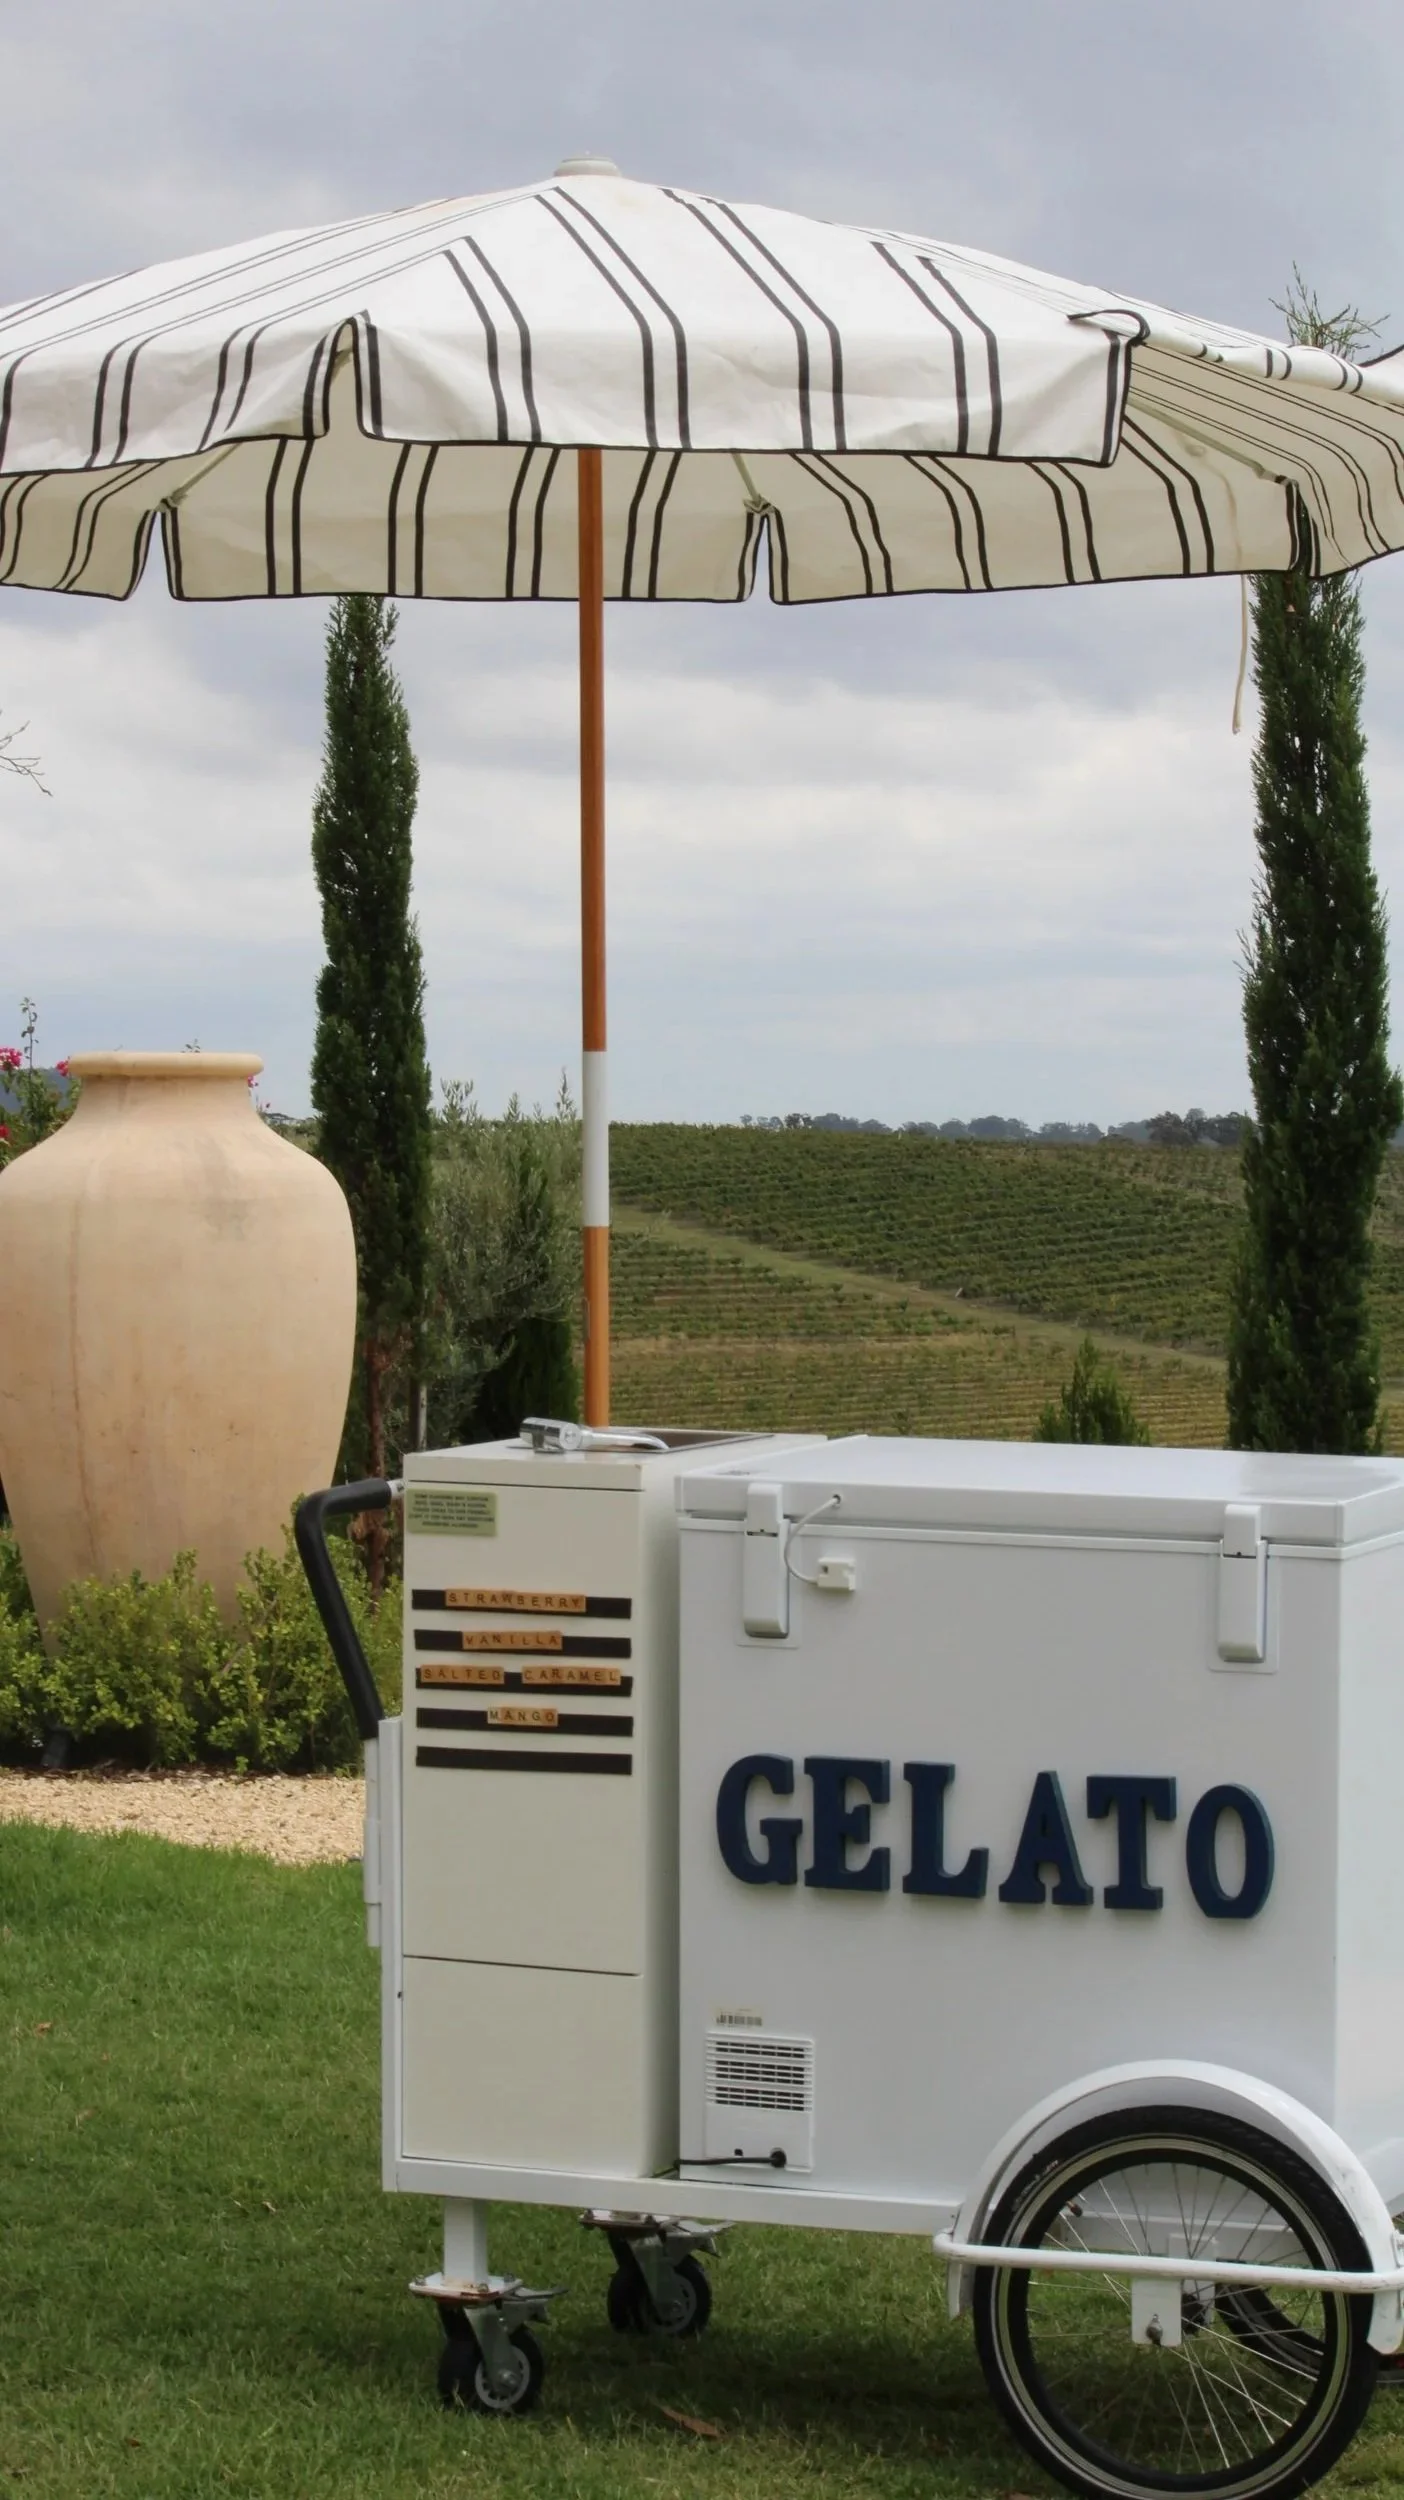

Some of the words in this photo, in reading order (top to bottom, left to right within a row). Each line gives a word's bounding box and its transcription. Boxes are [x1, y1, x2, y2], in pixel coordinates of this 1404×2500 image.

[449, 1591, 581, 1607] STRAWBERRY
[465, 1634, 559, 1646] VANILLA
[424, 1668, 501, 1680] SALTED
[525, 1668, 618, 1682] CARAMEL
[490, 1710, 555, 1722] MANGO
[716, 1753, 1276, 1920] GELATO
